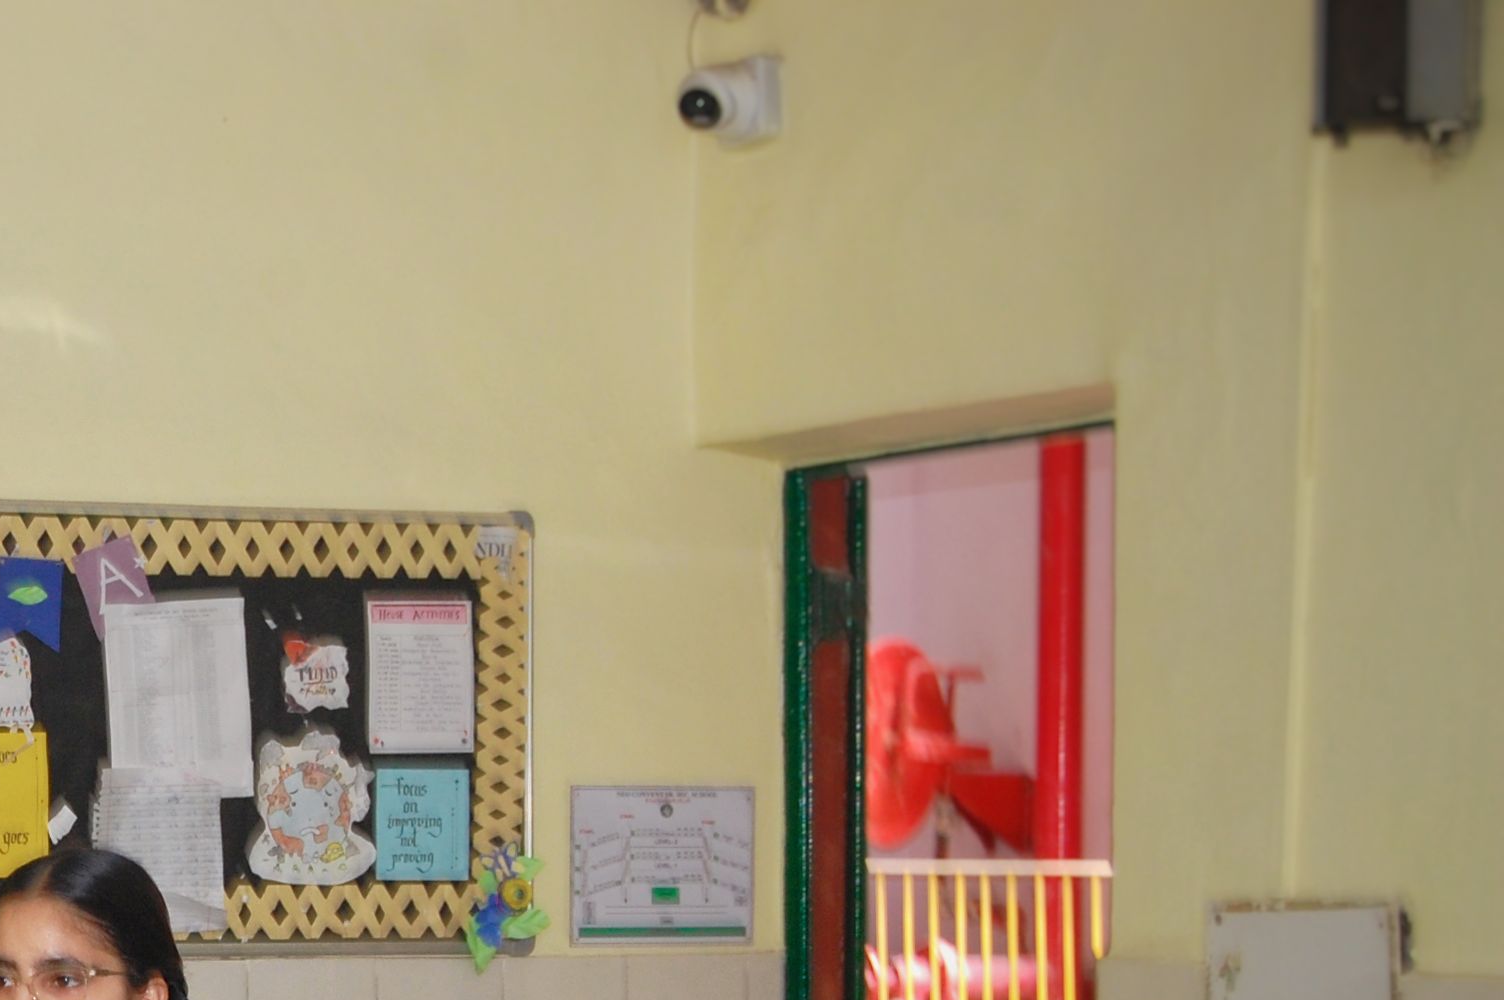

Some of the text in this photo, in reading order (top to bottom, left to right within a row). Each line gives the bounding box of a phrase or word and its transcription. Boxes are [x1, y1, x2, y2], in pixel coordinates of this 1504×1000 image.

[99, 557, 145, 616] A
[384, 777, 428, 797] Focus
[403, 801, 418, 814] on
[0, 832, 30, 854] goes
[386, 850, 434, 873] proving
